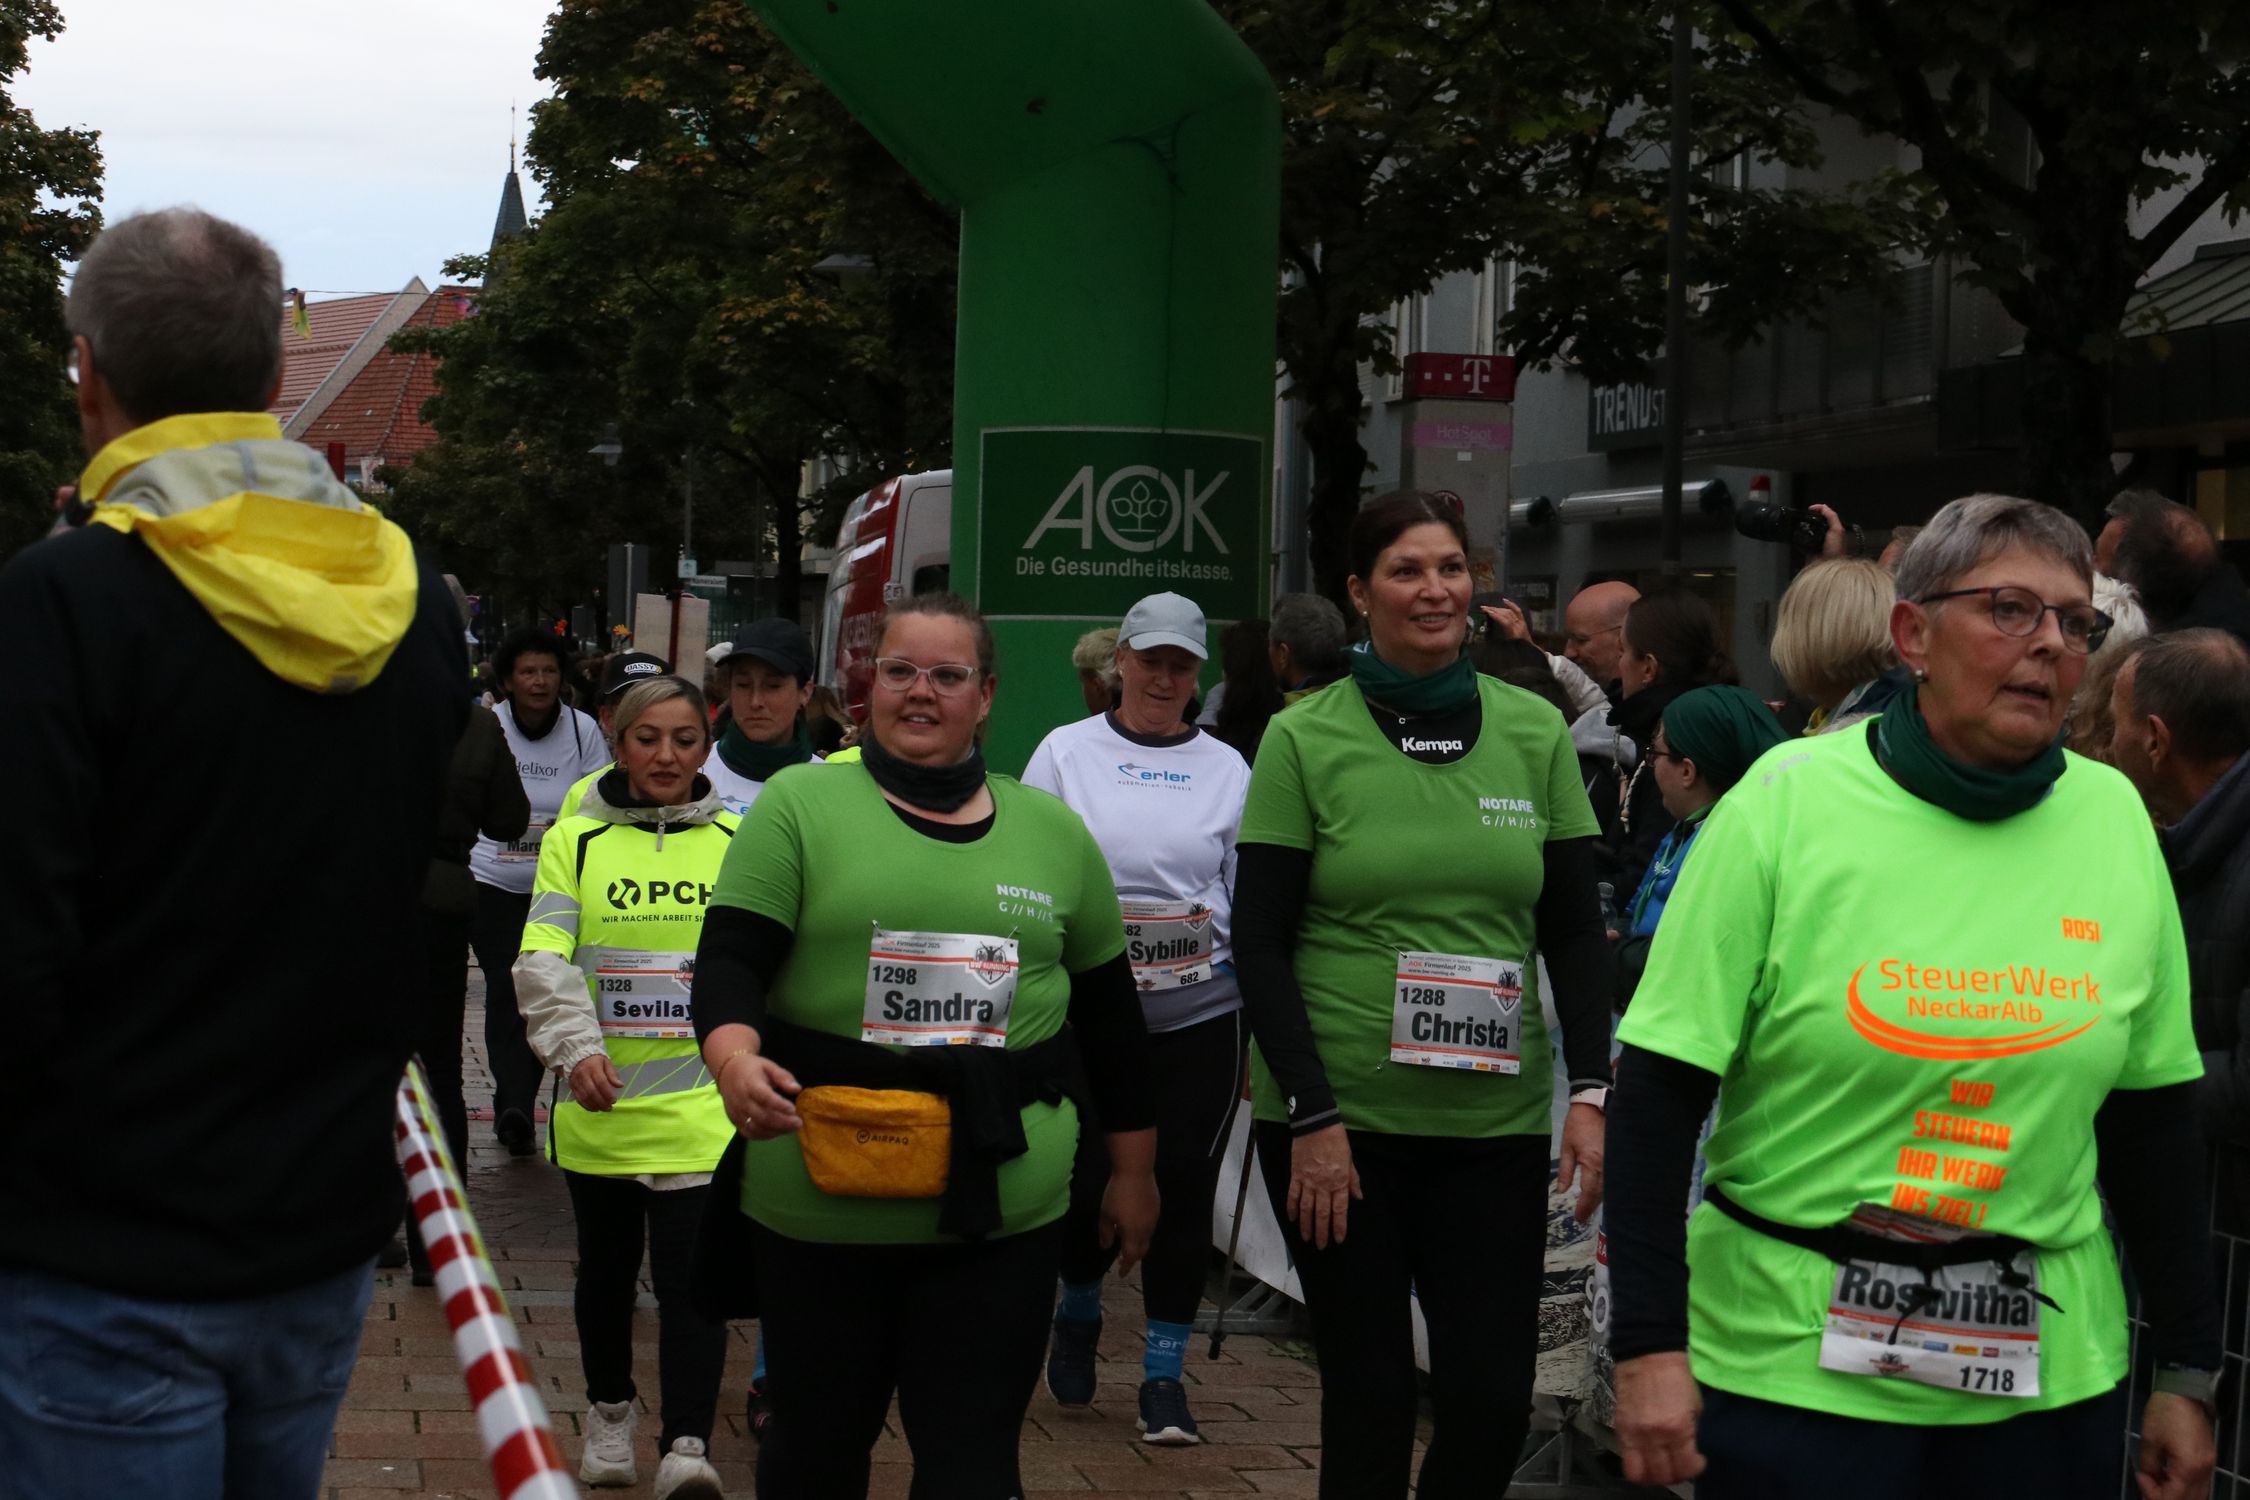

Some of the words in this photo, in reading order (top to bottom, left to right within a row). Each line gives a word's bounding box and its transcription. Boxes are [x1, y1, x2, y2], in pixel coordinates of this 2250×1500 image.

[1021, 464, 1231, 554] AOK
[1016, 556, 1045, 576] Die
[1051, 556, 1233, 581] Gesundheitskasse.
[1401, 736, 1463, 754] Kempa
[1141, 770, 1191, 782] erler
[1478, 797, 1534, 813] NOTARE
[996, 883, 1053, 907] NOTARE
[601, 915, 619, 923] WIR
[621, 914, 660, 923] MACHEN
[662, 914, 692, 922] ARBEIT
[1124, 925, 1141, 936] 82
[2062, 917, 2100, 943] ROSI
[1130, 938, 1199, 964] Sybille
[599, 979, 633, 992] 1328
[872, 965, 918, 985] 1298
[1180, 971, 1199, 985] 682
[1879, 959, 2102, 1005] SteuerWerk
[883, 990, 994, 1023] Sandra
[1400, 986, 1446, 1006] 1288
[613, 1000, 696, 1021] Sevilay
[1907, 996, 2043, 1024] NeckarAlb
[1411, 1011, 1508, 1049] Christa
[1951, 1079, 1996, 1108] WIR
[1913, 1109, 2012, 1152] STEUERN
[1897, 1147, 1938, 1180] IHR
[1942, 1155, 2008, 1192] WERK
[1891, 1182, 1933, 1215] INS
[1960, 1366, 2014, 1392] 1718
